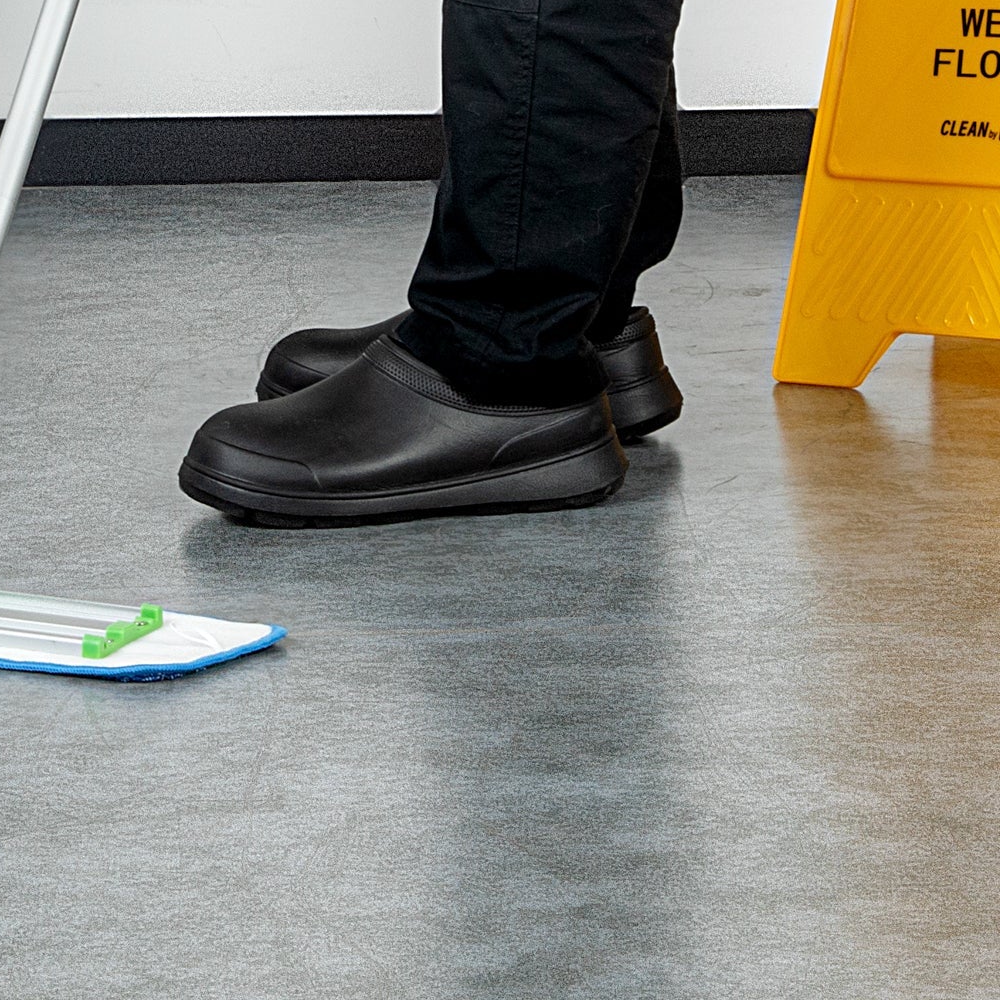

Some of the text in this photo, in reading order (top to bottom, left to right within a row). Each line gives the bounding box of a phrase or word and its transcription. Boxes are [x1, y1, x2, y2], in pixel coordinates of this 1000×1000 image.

[960, 8, 1000, 38] WE
[932, 48, 1000, 79] FLO
[940, 119, 990, 138] CLEAN
[989, 130, 998, 140] by
